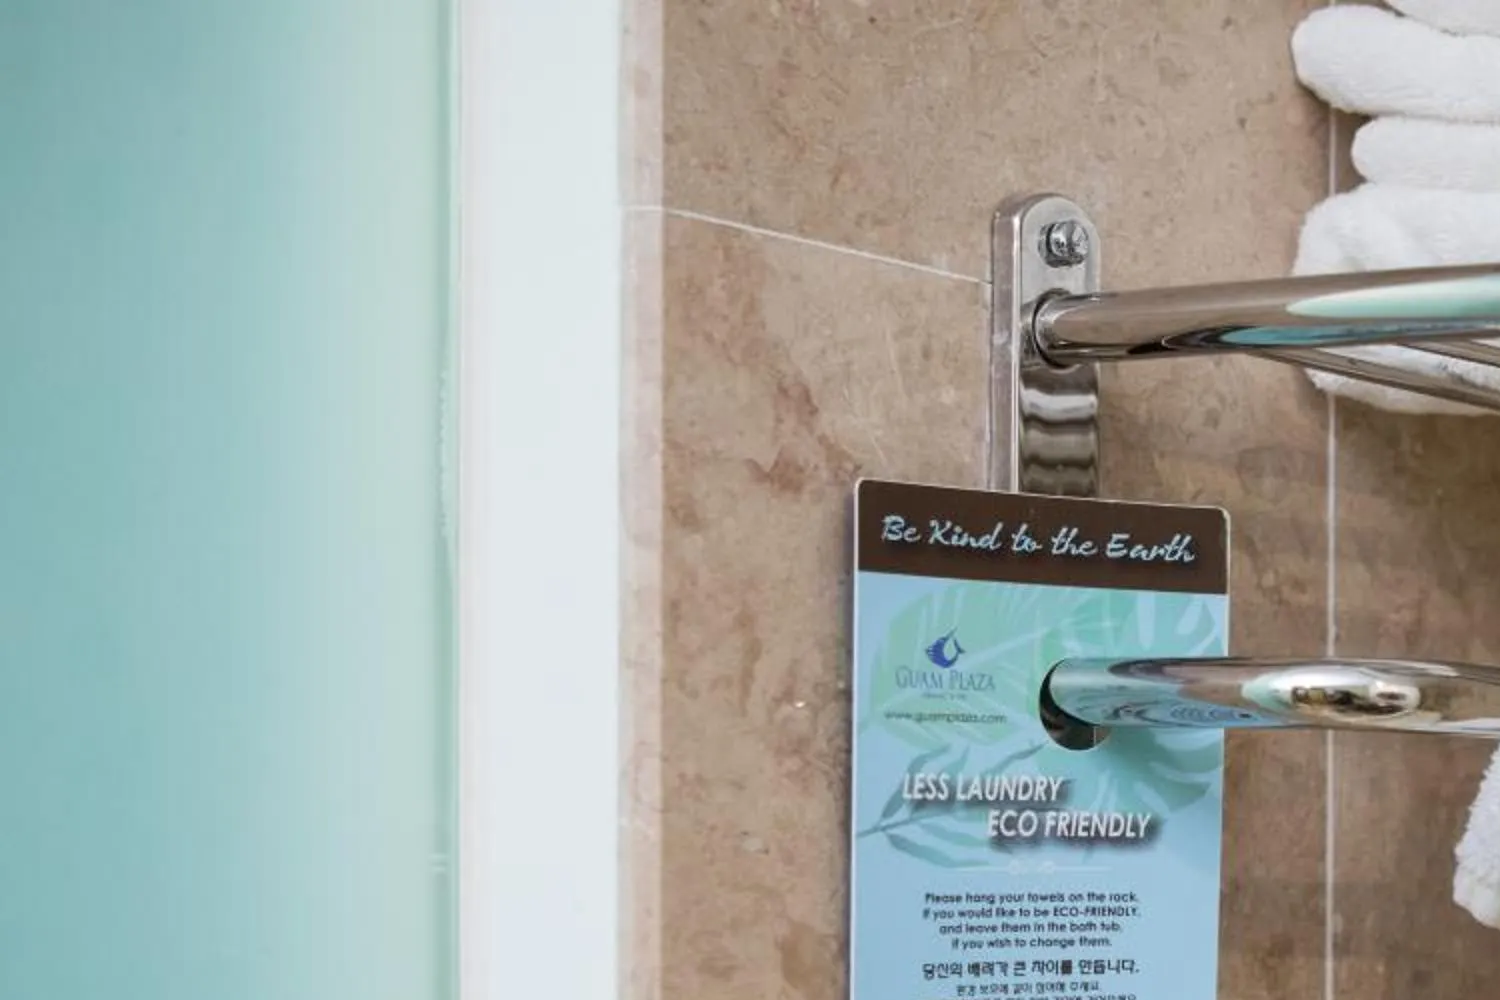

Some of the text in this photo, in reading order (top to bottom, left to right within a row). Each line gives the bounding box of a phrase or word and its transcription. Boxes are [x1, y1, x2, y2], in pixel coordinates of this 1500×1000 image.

[882, 515, 1195, 564] Be Kind to the Earth
[895, 665, 996, 691] GUAM PLAZA
[902, 773, 1066, 802] LESS LAUNDRY
[986, 809, 1152, 840] ECO FRIENDLY
[925, 892, 963, 903] Please
[965, 892, 995, 904] hang
[999, 893, 1025, 904] your
[1027, 892, 1065, 903] towels
[1068, 893, 1084, 902] on
[1087, 891, 1106, 902] the
[933, 909, 955, 921] you
[958, 907, 993, 919] would
[995, 907, 1016, 918] like
[1019, 907, 1031, 918] to
[1033, 907, 1049, 918] be
[939, 923, 962, 934] and
[965, 922, 998, 933] leave
[1001, 921, 1031, 933] them
[1033, 922, 1045, 933] in
[1047, 921, 1067, 933] the
[1070, 921, 1097, 932] bath
[961, 940, 984, 950] you
[987, 938, 1012, 949] wish
[1015, 938, 1027, 948] to
[1029, 937, 1075, 949] change
[922, 959, 1140, 980] 당신의 배려가 큰 차이를 만듭니다.
